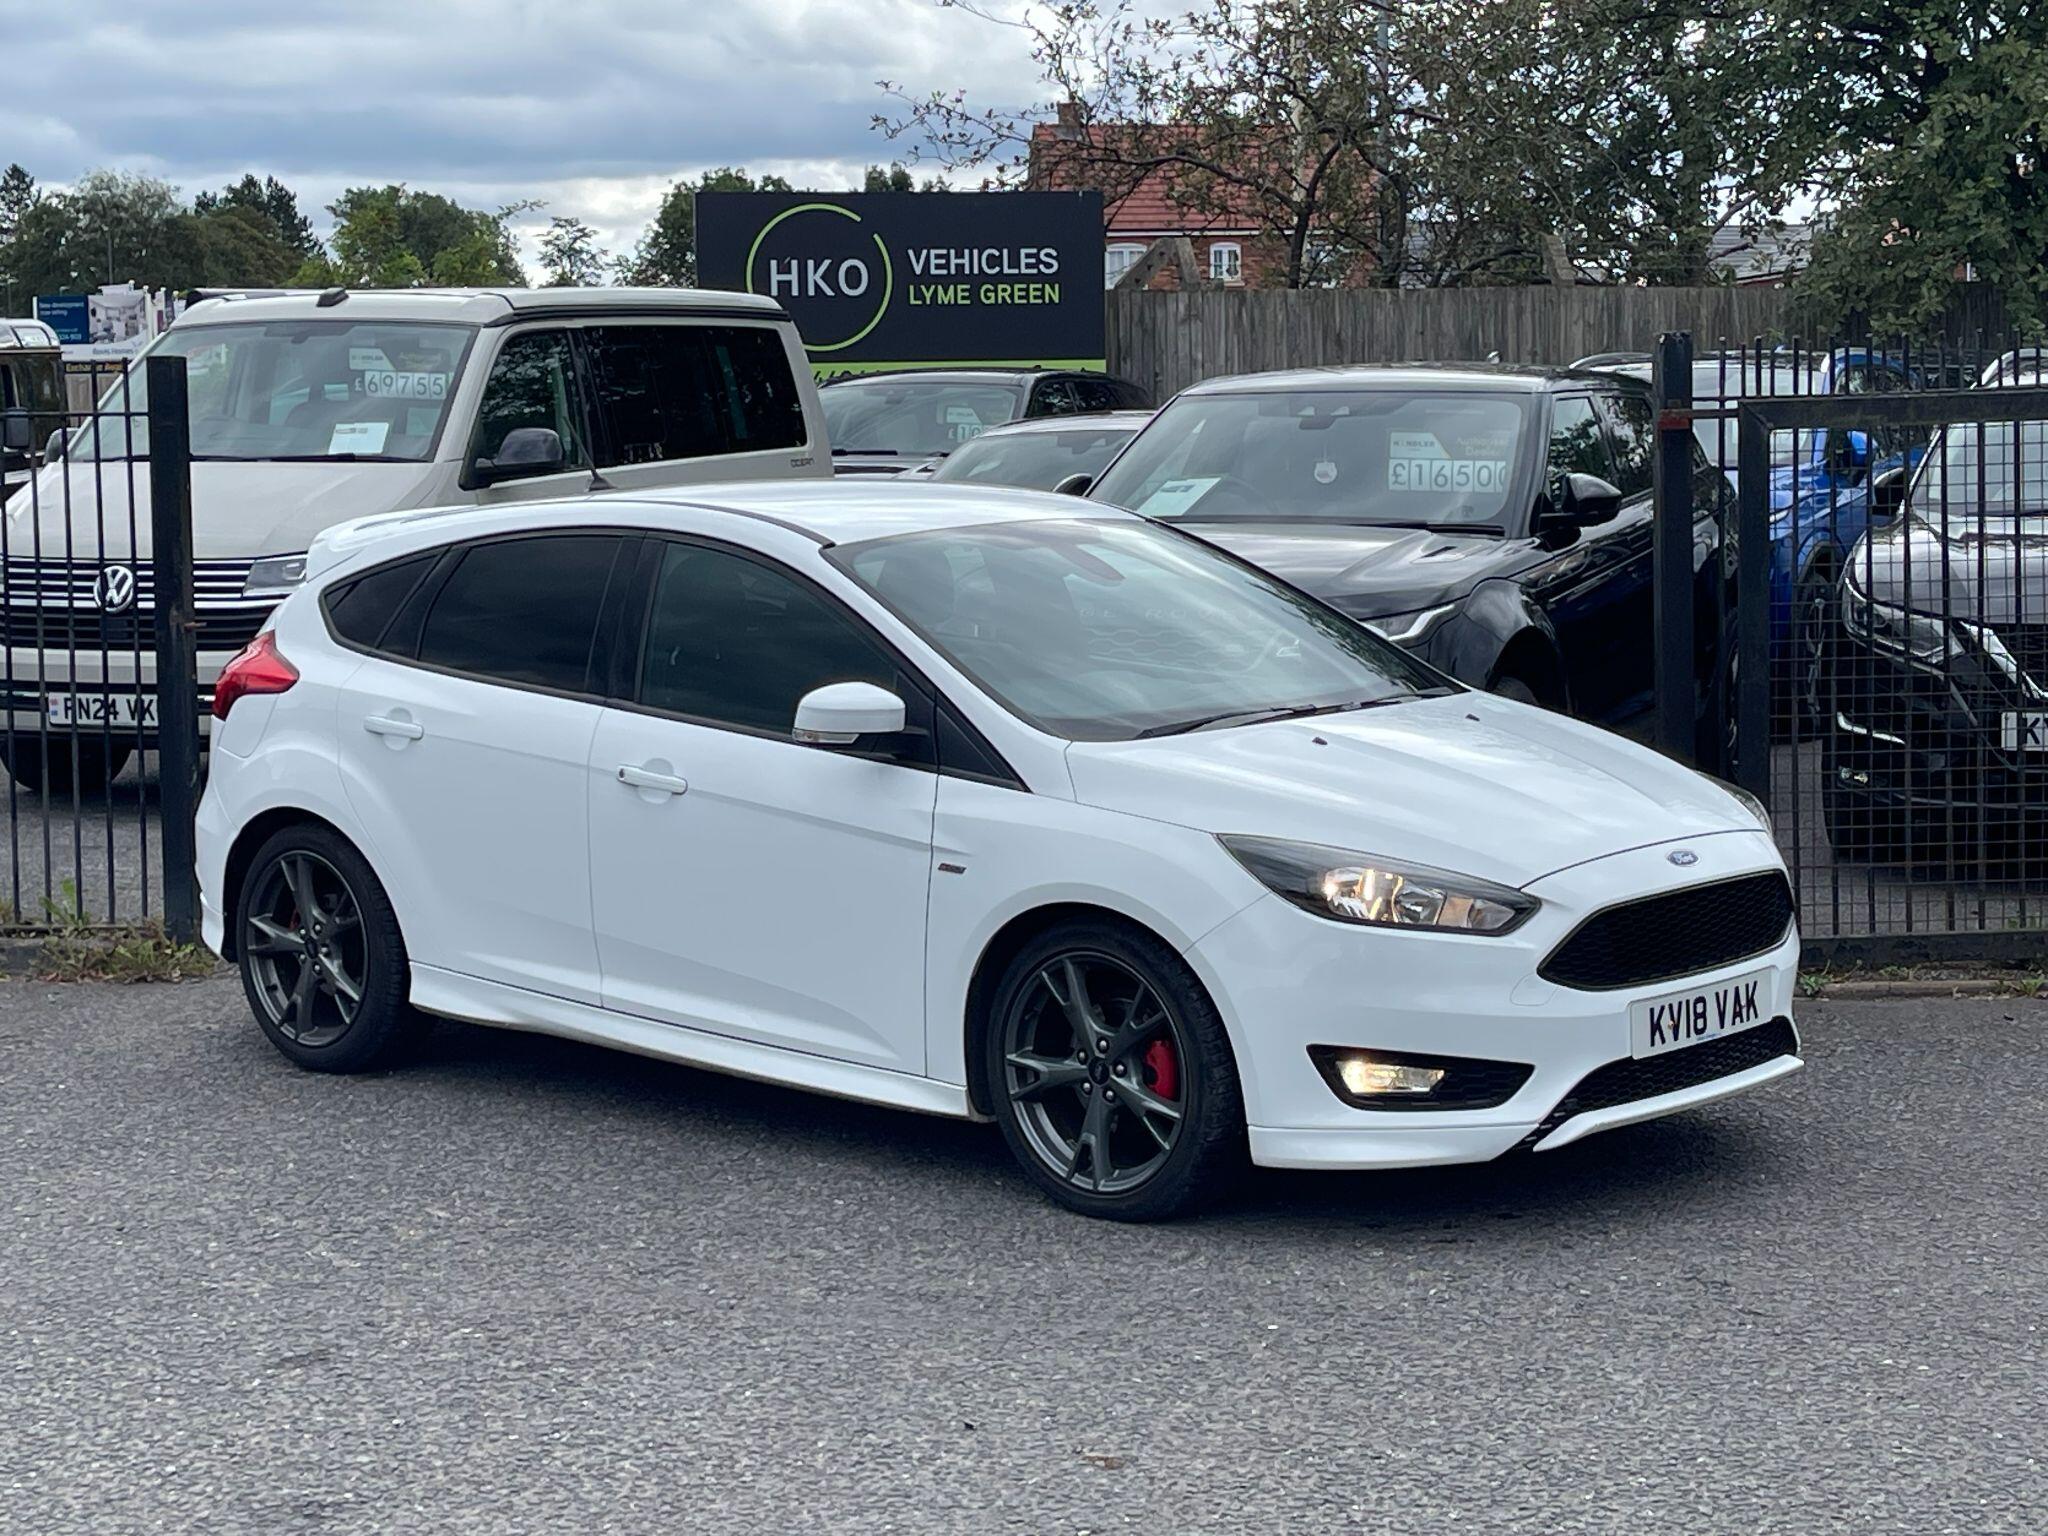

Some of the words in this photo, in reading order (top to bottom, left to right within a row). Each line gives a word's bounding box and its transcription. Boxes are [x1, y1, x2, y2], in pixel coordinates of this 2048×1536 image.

[908, 247, 1060, 275] VEHICLES
[769, 258, 869, 297] HKO
[909, 285, 971, 305] LYME
[980, 284, 1060, 304] GREEN
[354, 374, 444, 396] £69755
[126, 698, 156, 721] VK
[1649, 995, 1707, 1047] KV18
[1715, 980, 1759, 1030] VAK
